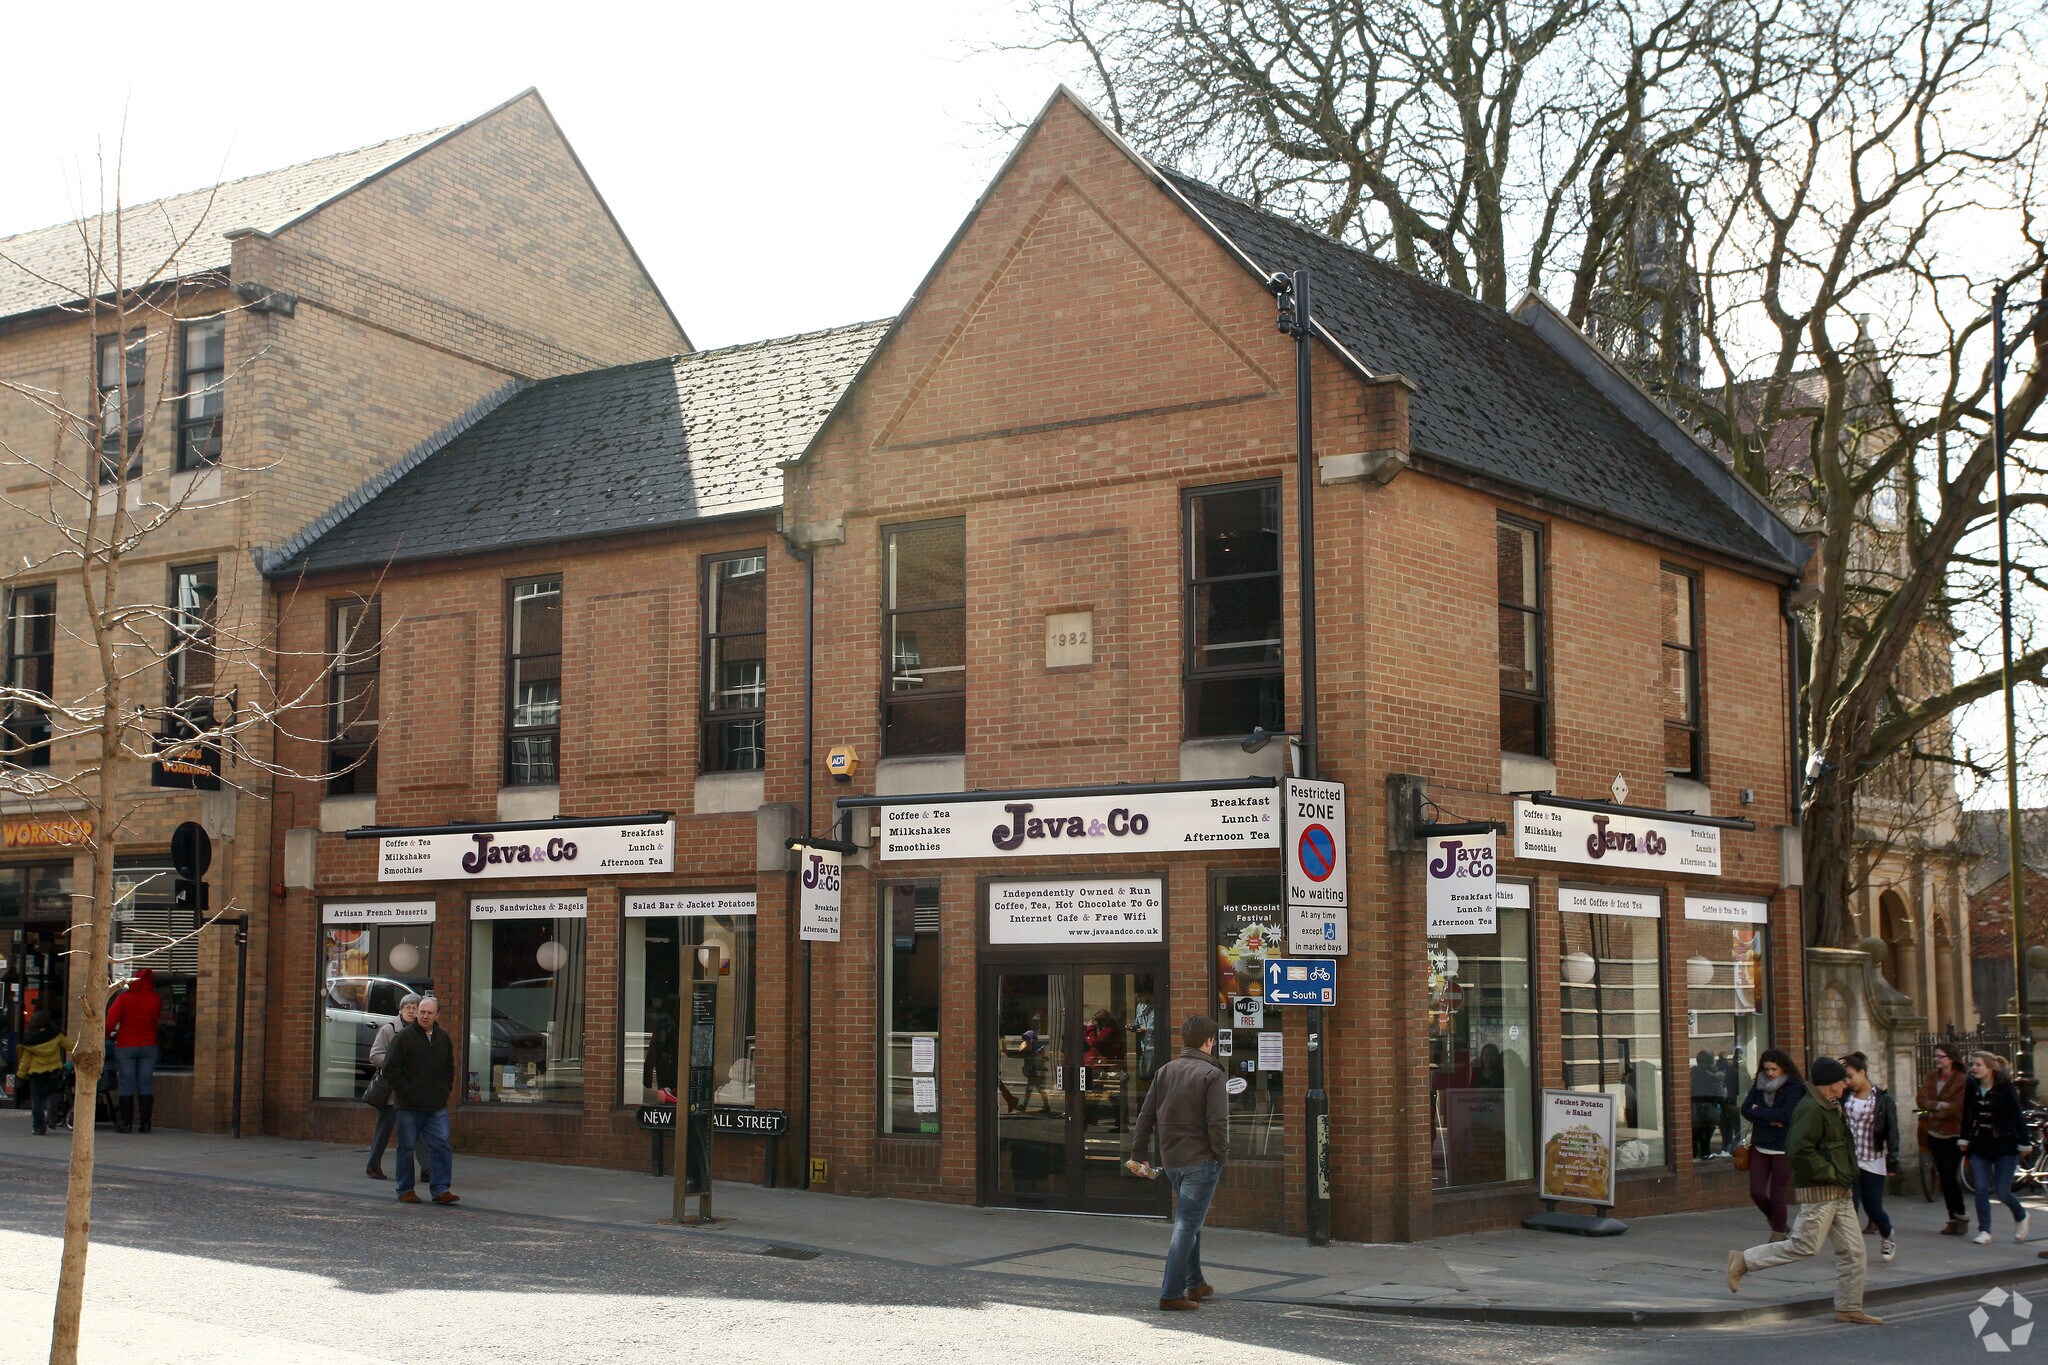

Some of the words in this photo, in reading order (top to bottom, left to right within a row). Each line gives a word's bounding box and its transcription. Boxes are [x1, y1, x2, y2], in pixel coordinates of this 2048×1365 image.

[1051, 632, 1088, 648] 1982
[832, 757, 845, 765] ADT
[1291, 785, 1341, 801] Restricted
[1211, 797, 1270, 808] Breakfast
[889, 811, 919, 821] Coffee
[922, 810, 929, 819] &
[933, 810, 950, 819] Tea
[1298, 803, 1334, 820] ZONE
[1523, 809, 1543, 820] Coffee
[1551, 812, 1562, 821] Tea
[1221, 814, 1259, 824] Lunch
[1261, 813, 1270, 822] &
[2, 821, 95, 847] WORKSHOP
[621, 829, 664, 838] Breakfast
[889, 826, 951, 837] Milkshakes
[1183, 831, 1244, 842] Afternoon
[1250, 831, 1270, 841] Tea
[1524, 825, 1562, 838] Milkshakes
[1690, 829, 1716, 840] Breakfast
[385, 839, 408, 848] Coffee
[410, 839, 416, 847] &
[418, 838, 431, 847] Tea
[628, 843, 655, 852] Lunch
[657, 843, 664, 851] &
[888, 842, 941, 852] Smoothies
[1524, 842, 1557, 853] Smoothies
[1696, 844, 1712, 854] Lunch
[385, 852, 431, 861] Milkshakes
[600, 857, 644, 868] Afternoon
[648, 856, 664, 866] Tea
[1429, 840, 1494, 879] Java
[1679, 857, 1707, 867] Afternoon
[1708, 860, 1717, 868] Tea
[384, 866, 423, 874] Smoothies
[803, 855, 840, 889] Java
[1003, 889, 1075, 899] Independently
[1079, 888, 1114, 896] Owned
[1118, 887, 1125, 895] &
[1129, 887, 1151, 895] Run
[1291, 886, 1306, 899] No
[1309, 888, 1344, 902] waiting
[1451, 893, 1493, 901] Breakfast
[475, 905, 497, 914] Soup,
[499, 903, 546, 912] Sandwiches
[549, 903, 556, 911] &
[558, 902, 584, 912] Bagels
[632, 902, 656, 910] Salad
[659, 901, 675, 909] Bar
[677, 901, 684, 909] &
[686, 900, 715, 909] Jacket
[718, 900, 755, 908] Potatoes
[815, 904, 839, 912] Breakfast
[994, 901, 1028, 911] Coffee,
[1030, 902, 1051, 911] Tea,
[1055, 901, 1074, 909] Hot
[1078, 900, 1127, 909] Chocolate
[1131, 899, 1142, 908] To
[1146, 899, 1159, 907] Go
[1223, 904, 1238, 912] Hot
[1241, 904, 1281, 912] Chocolat
[1573, 896, 1587, 906] Iced
[1589, 897, 1609, 908] Coffee
[1617, 899, 1630, 909] Iced
[1632, 900, 1643, 910] Tea
[334, 909, 363, 917] Artisan
[366, 908, 392, 917] French
[395, 908, 428, 916] Desserts
[1456, 905, 1482, 913] Lunch
[1702, 905, 1718, 914] Coffee
[1724, 907, 1733, 915] Tea
[1734, 907, 1740, 915] To
[1741, 907, 1748, 916] Go
[818, 915, 833, 923] Lunch
[1009, 914, 1052, 923] Internet
[1057, 914, 1079, 922] Cafe
[1083, 913, 1090, 921] &
[1095, 913, 1118, 921] Free
[1123, 912, 1147, 921] Wifi
[1236, 914, 1272, 922] Festival
[1300, 910, 1309, 919] At
[1310, 912, 1321, 920] any
[1322, 911, 1336, 919] time
[1431, 919, 1474, 927] Afternoon
[803, 926, 828, 934] Afternoon
[1068, 928, 1159, 937] www.javaandco.co.uk
[1301, 927, 1323, 936] except
[1295, 942, 1302, 950] in
[1303, 943, 1327, 951] marked
[1328, 944, 1342, 952] bays
[1292, 991, 1317, 999] South
[1241, 1017, 1255, 1025] FREE
[1554, 1098, 1579, 1107] Jacket
[1580, 1100, 1604, 1109] Potato
[643, 1110, 672, 1125] NEW
[1572, 1109, 1592, 1117] Salad
[737, 1114, 780, 1131] STREET
[812, 1160, 826, 1180] H
